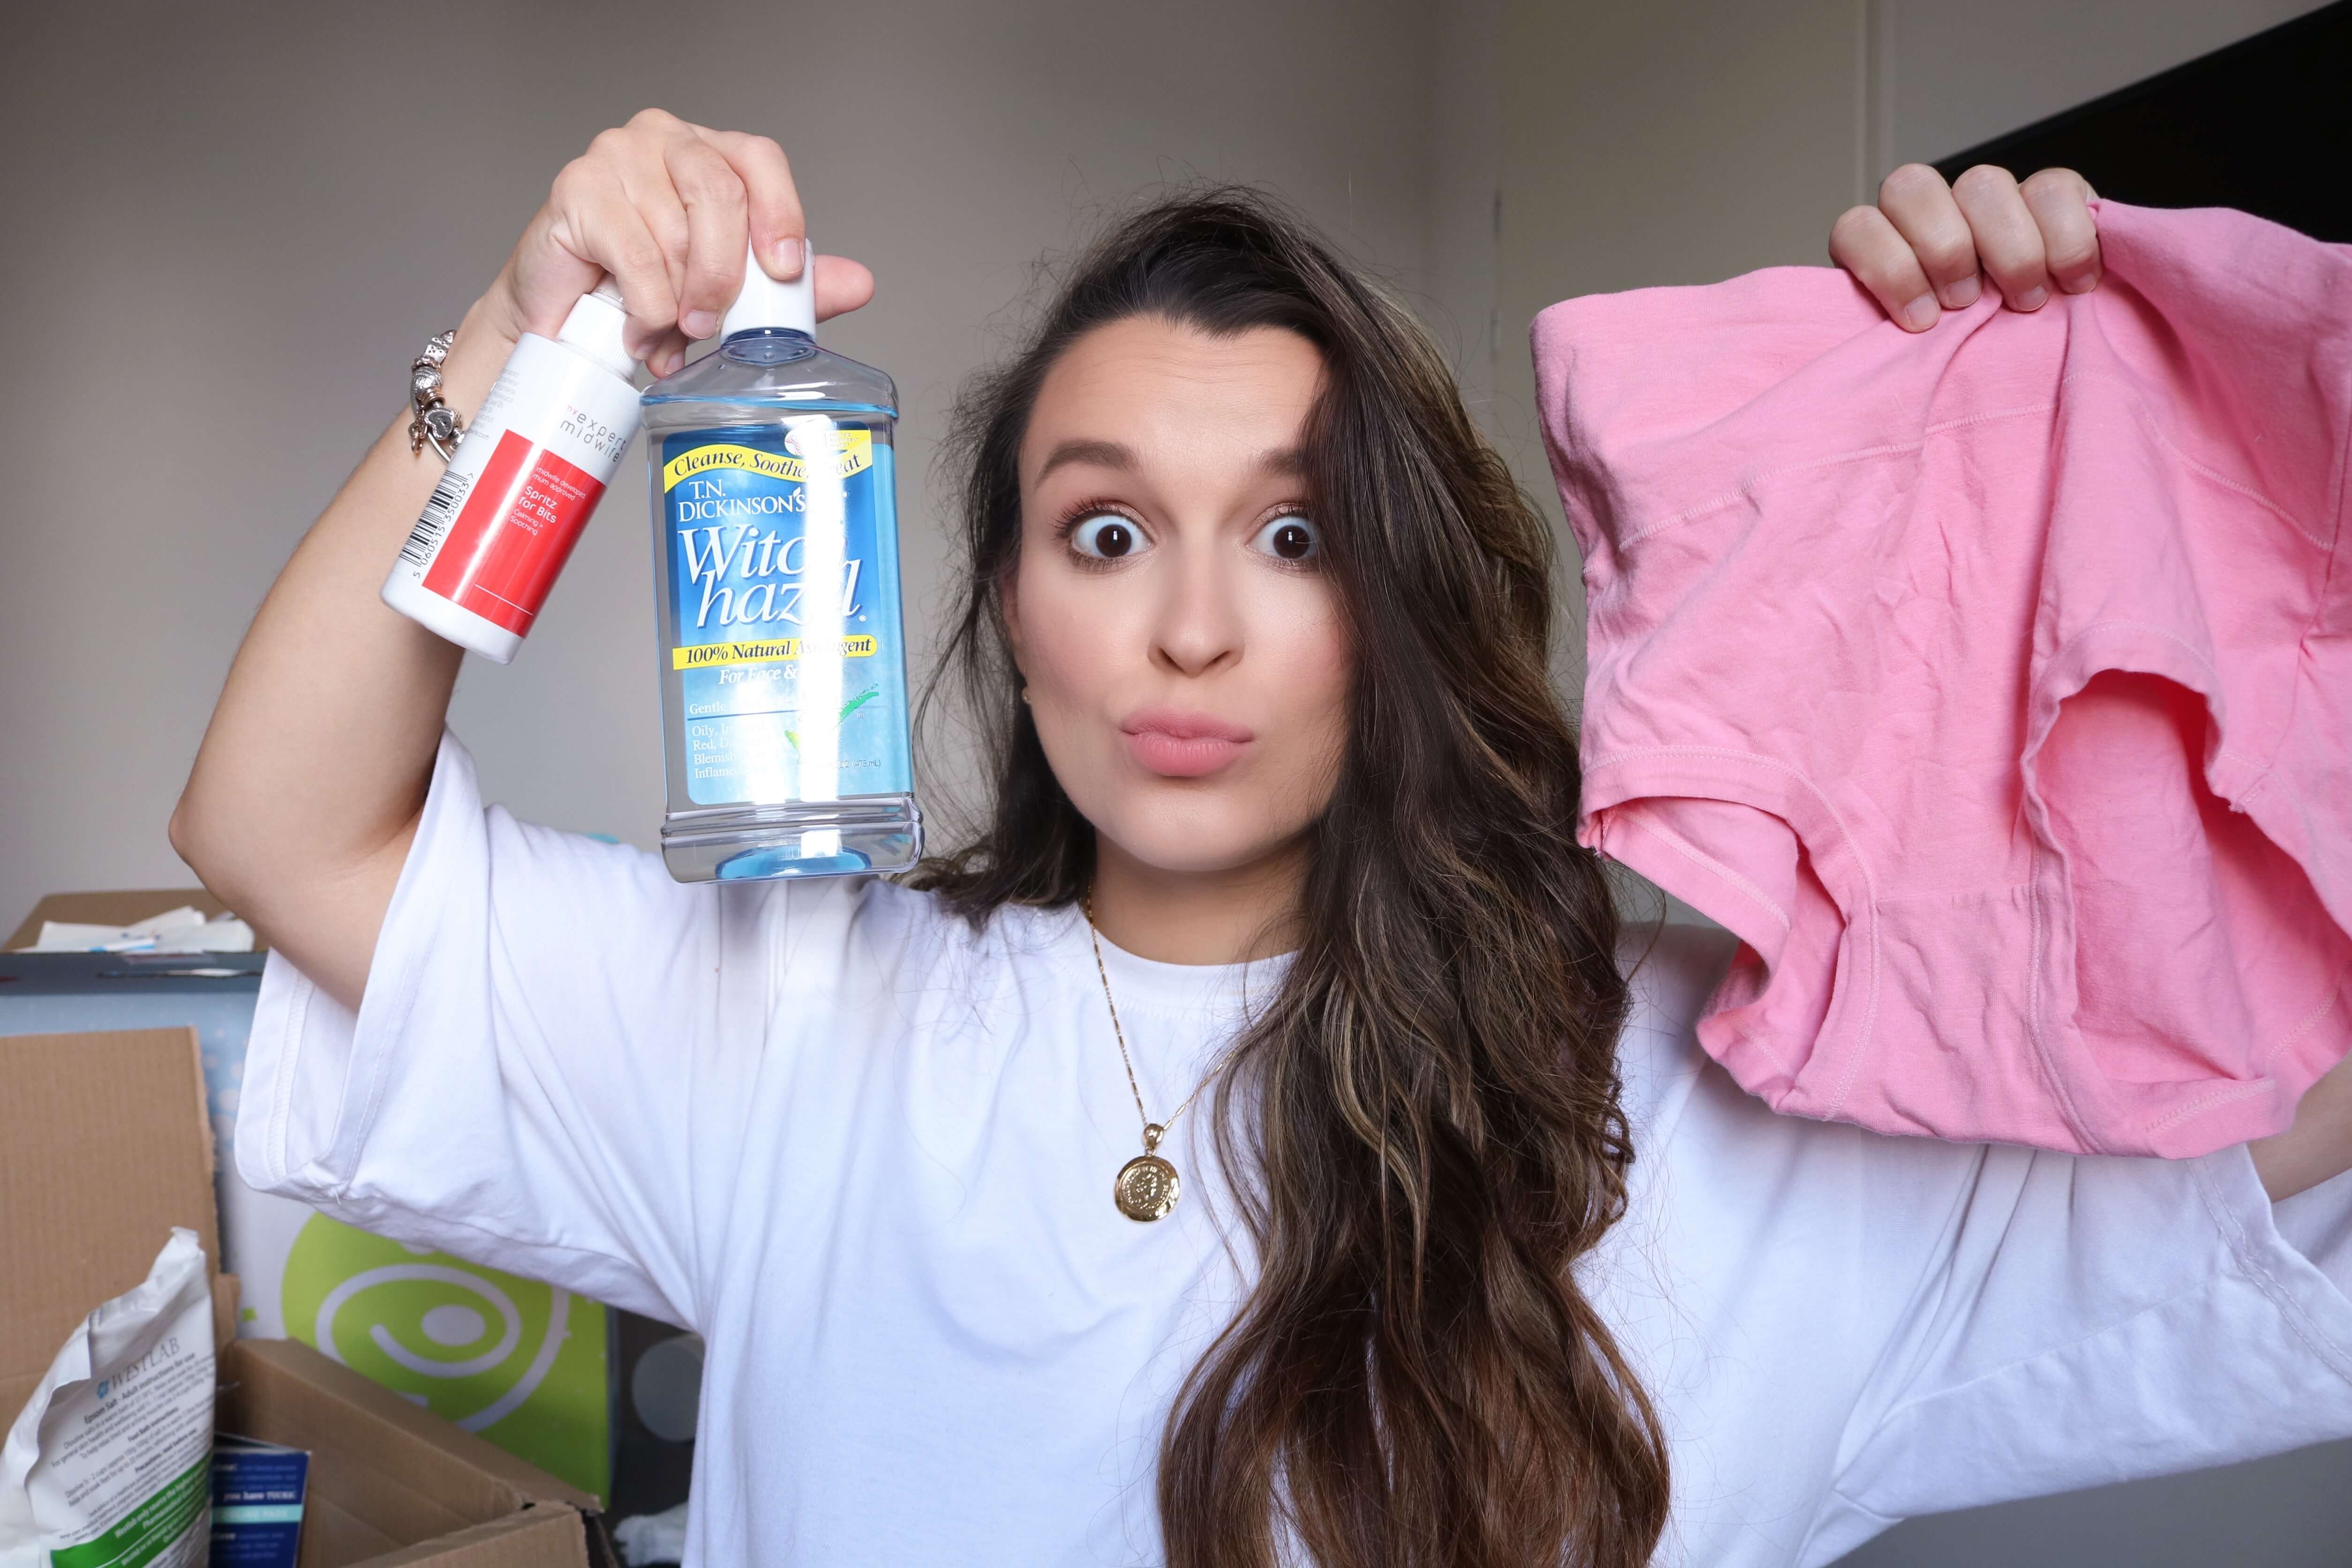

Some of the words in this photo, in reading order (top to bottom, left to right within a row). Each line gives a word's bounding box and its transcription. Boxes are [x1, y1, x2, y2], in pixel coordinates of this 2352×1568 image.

[560, 420, 619, 462] midwife
[577, 413, 626, 451] expert
[536, 467, 560, 482] midwife
[674, 451, 745, 476] Cleanse,
[525, 485, 558, 510] Spritz
[533, 474, 549, 485] mum
[550, 483, 576, 501] approved
[688, 479, 726, 500] T.N.
[444, 482, 469, 522] 350033
[518, 496, 536, 511] for
[536, 506, 557, 523] Bits
[678, 493, 806, 522] DICKINSON'S
[509, 516, 538, 536] Soothing
[513, 508, 539, 527] Calming
[420, 526, 445, 565] 060515
[678, 524, 843, 586] Witc
[696, 559, 860, 628] hazl
[686, 645, 728, 663] 100%
[732, 641, 791, 659] Natural
[718, 669, 744, 685] For
[747, 664, 781, 682] Face
[689, 701, 726, 715] Gentle
[692, 725, 718, 738] Oily,
[693, 738, 716, 751] Red,
[868, 759, 881, 768] mL)
[112, 1335, 179, 1390] WESTLAB
[84, 1408, 104, 1424] Epsom
[106, 1397, 117, 1410] Salt
[122, 1384, 138, 1401] Adult
